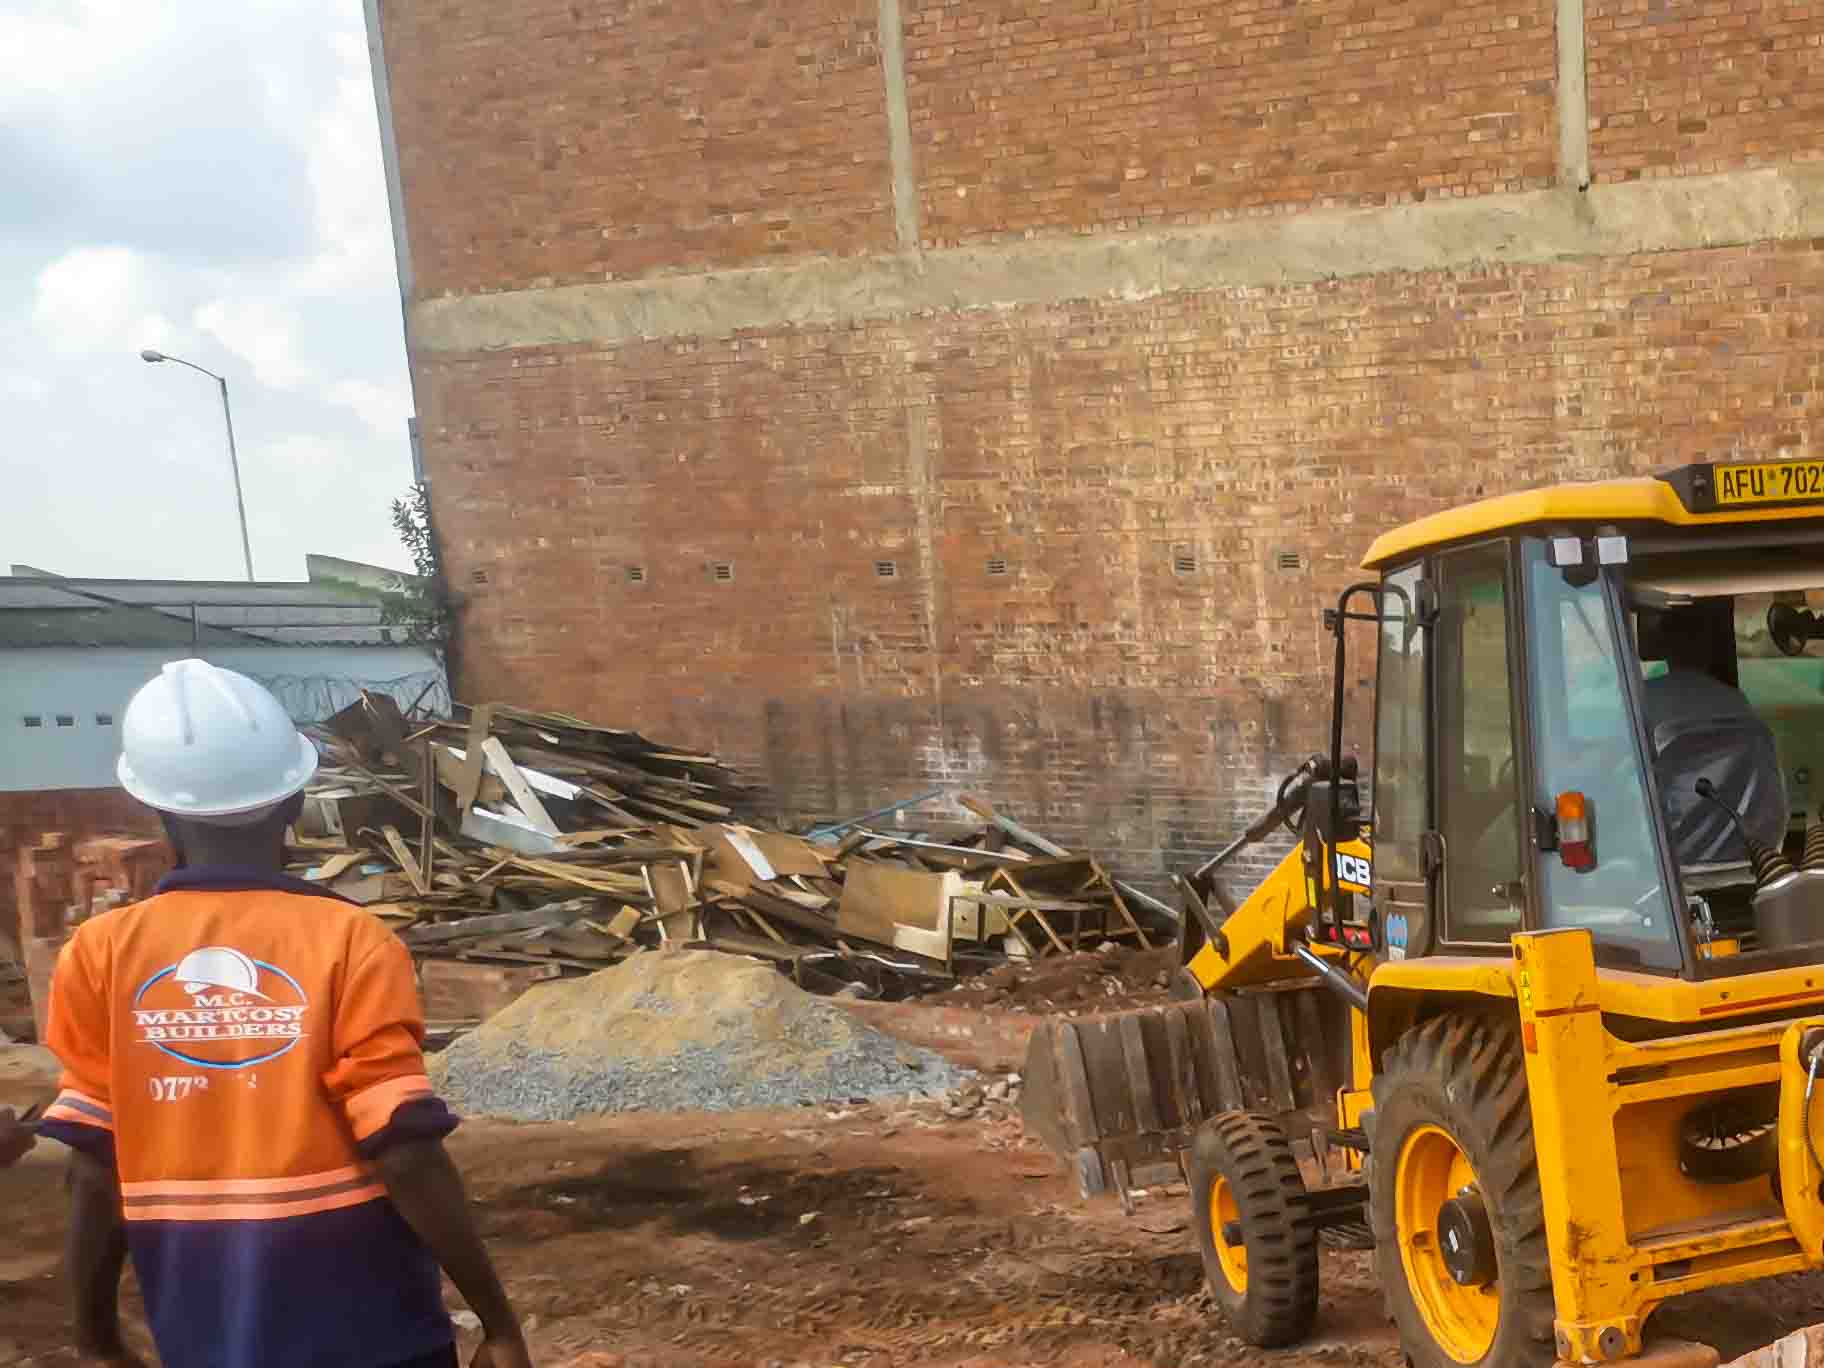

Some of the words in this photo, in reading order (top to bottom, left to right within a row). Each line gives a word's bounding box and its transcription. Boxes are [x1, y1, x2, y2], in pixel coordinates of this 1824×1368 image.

[1723, 468, 1765, 499] AFU
[191, 992, 253, 1008] M.C.
[145, 1023, 301, 1040] BUILDERS
